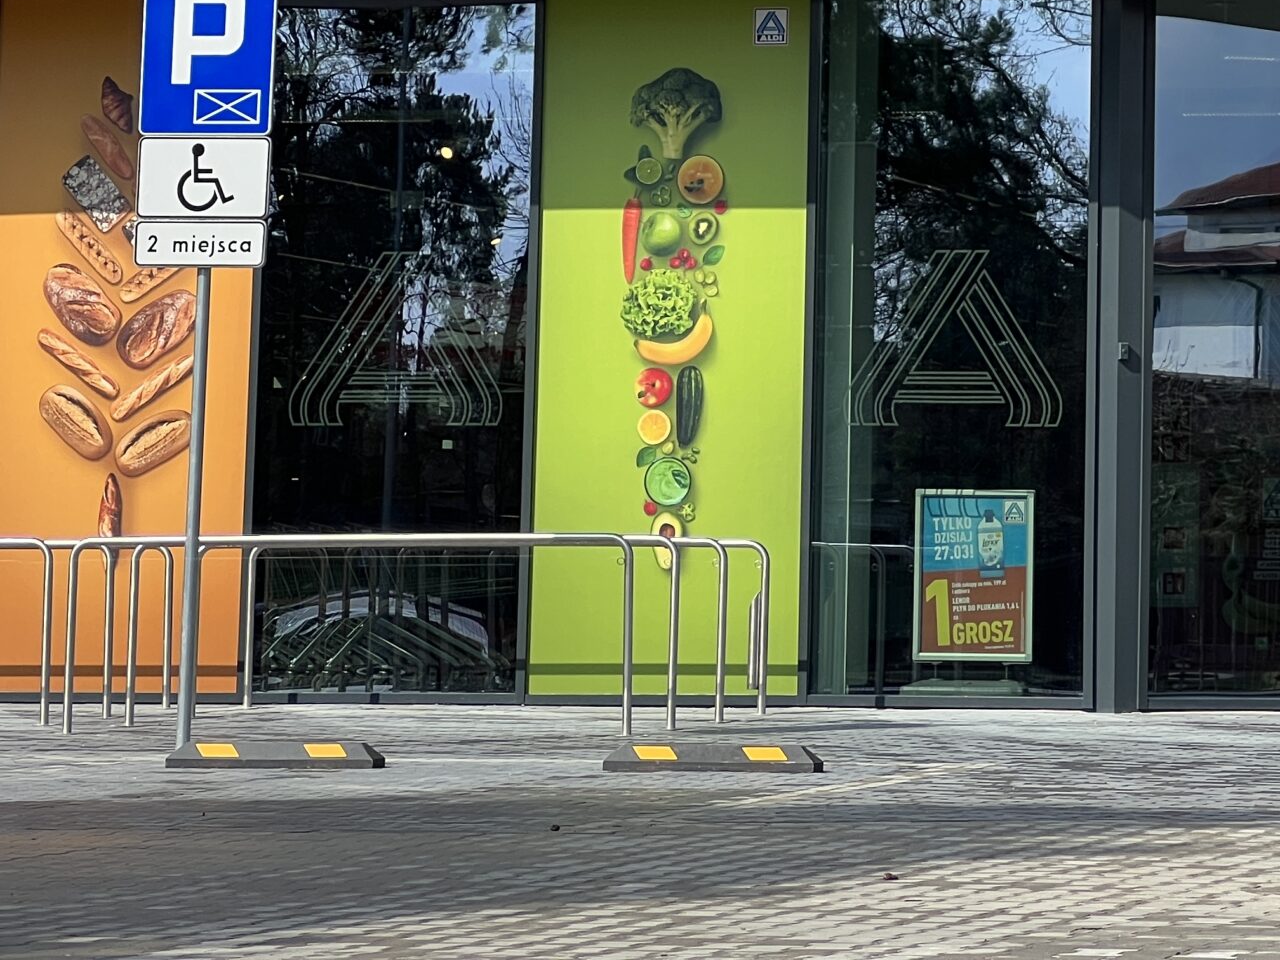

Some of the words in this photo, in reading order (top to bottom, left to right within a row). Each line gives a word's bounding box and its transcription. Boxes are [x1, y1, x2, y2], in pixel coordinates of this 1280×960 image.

[147, 235, 158, 253] 2
[172, 235, 252, 258] miejsca
[932, 517, 972, 531] TYLKO
[934, 531, 973, 544] DZISIAJ
[934, 544, 974, 561] 27.03!
[925, 578, 951, 647] 1
[952, 620, 1014, 645] GROSZ
